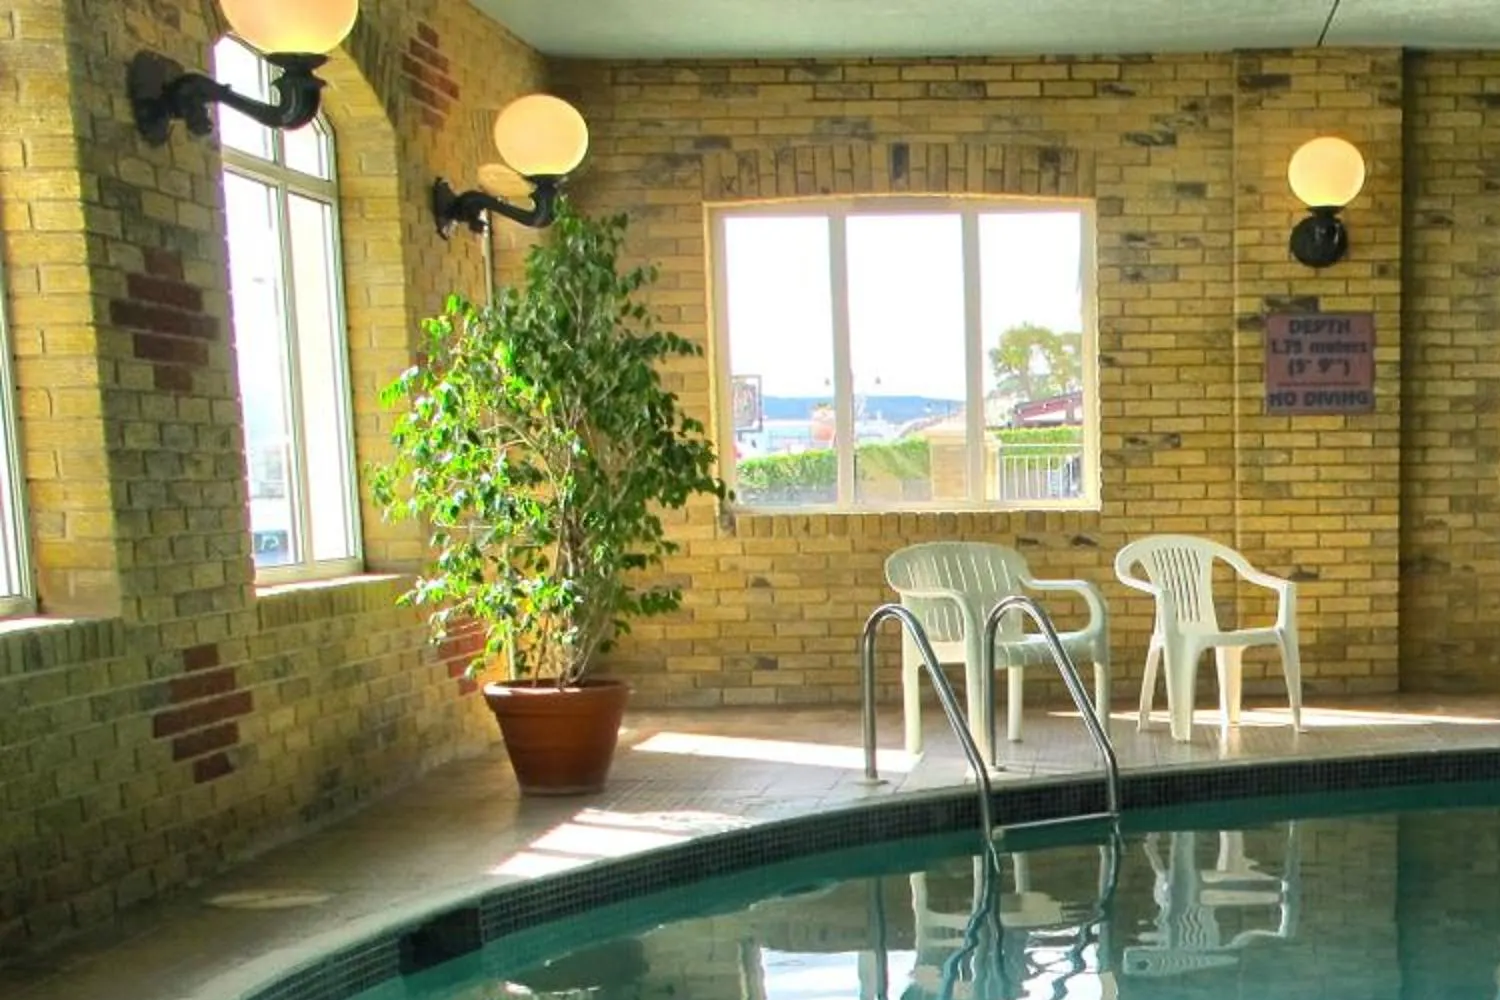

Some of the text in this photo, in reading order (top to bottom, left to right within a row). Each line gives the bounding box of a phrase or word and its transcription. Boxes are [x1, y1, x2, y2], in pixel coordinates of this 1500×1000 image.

[1289, 319, 1350, 334] DEPTH
[1269, 390, 1368, 407] NO DIVING
